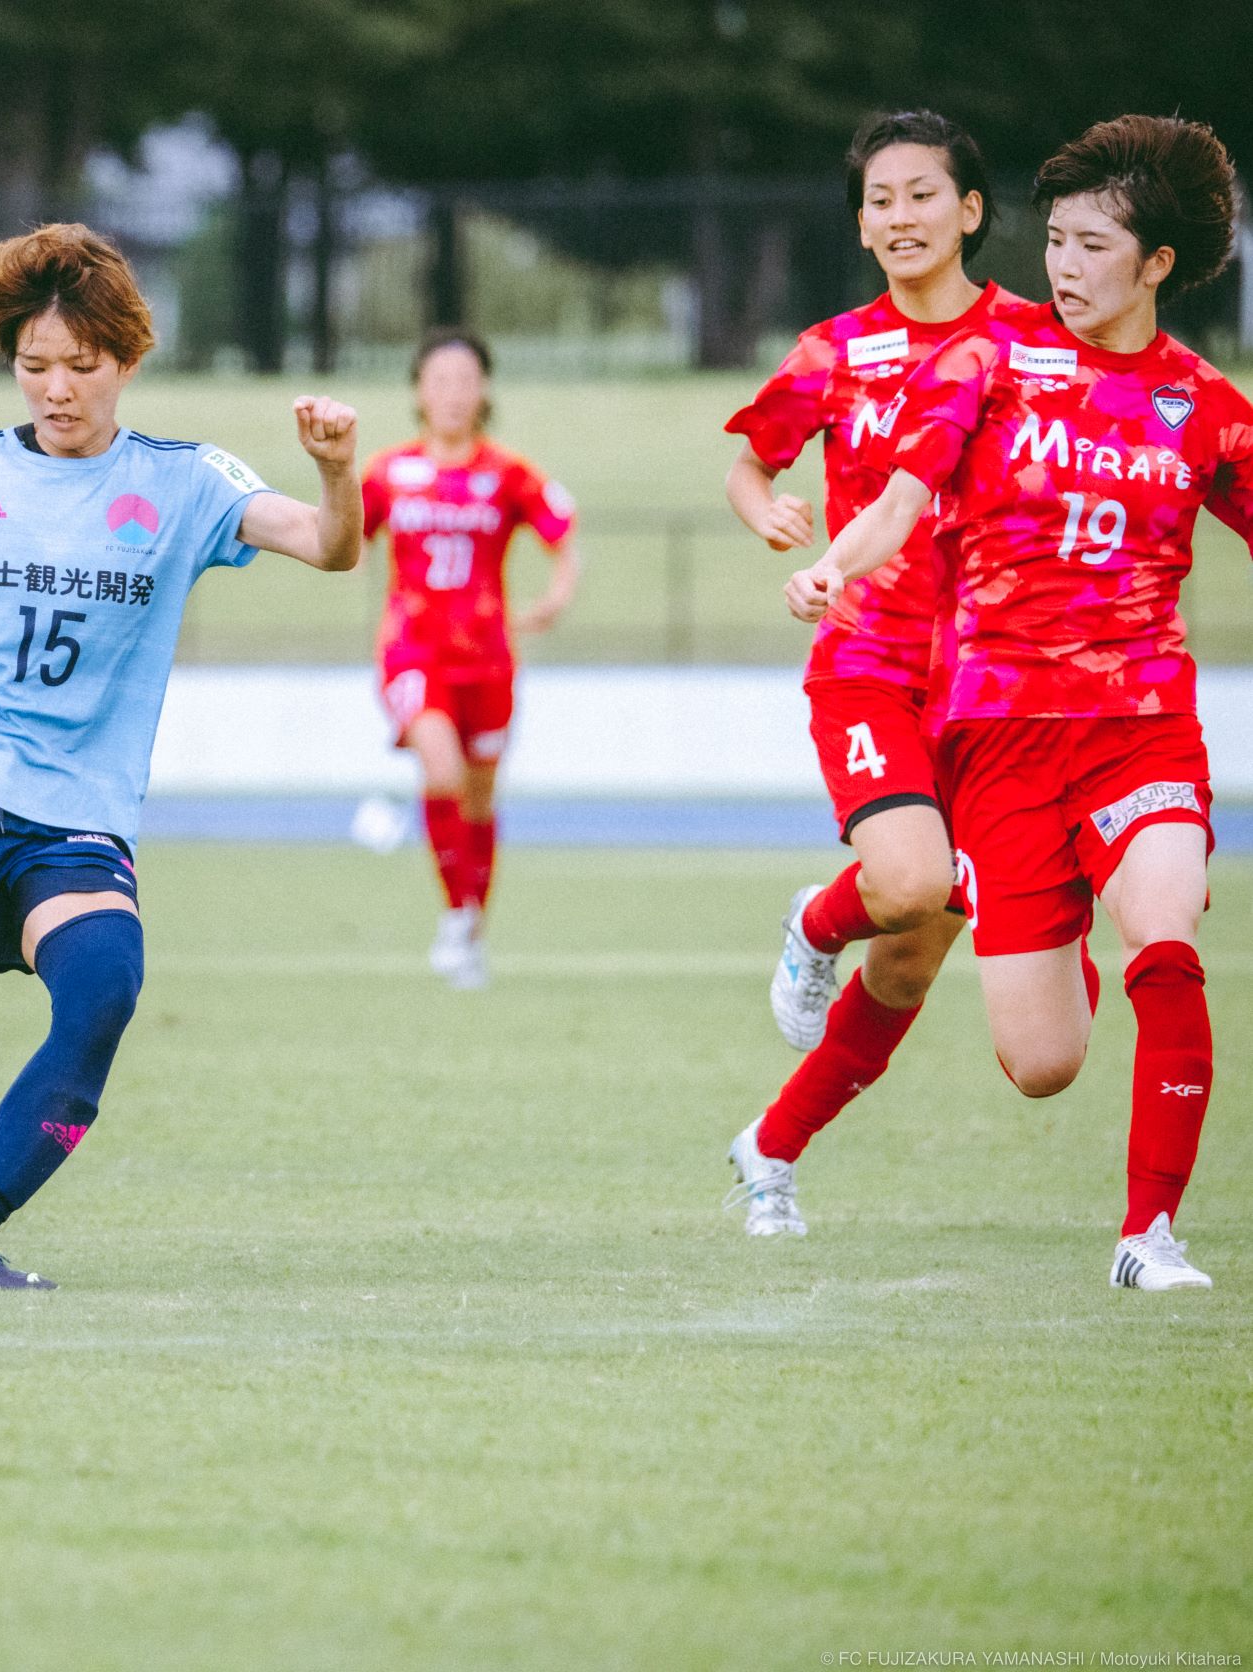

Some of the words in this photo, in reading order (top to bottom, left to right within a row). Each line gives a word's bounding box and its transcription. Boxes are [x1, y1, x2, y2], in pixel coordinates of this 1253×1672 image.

[1057, 491, 1127, 565] 19
[14, 604, 87, 687] 15
[846, 722, 887, 779] 4
[1130, 782, 1194, 805] エポック
